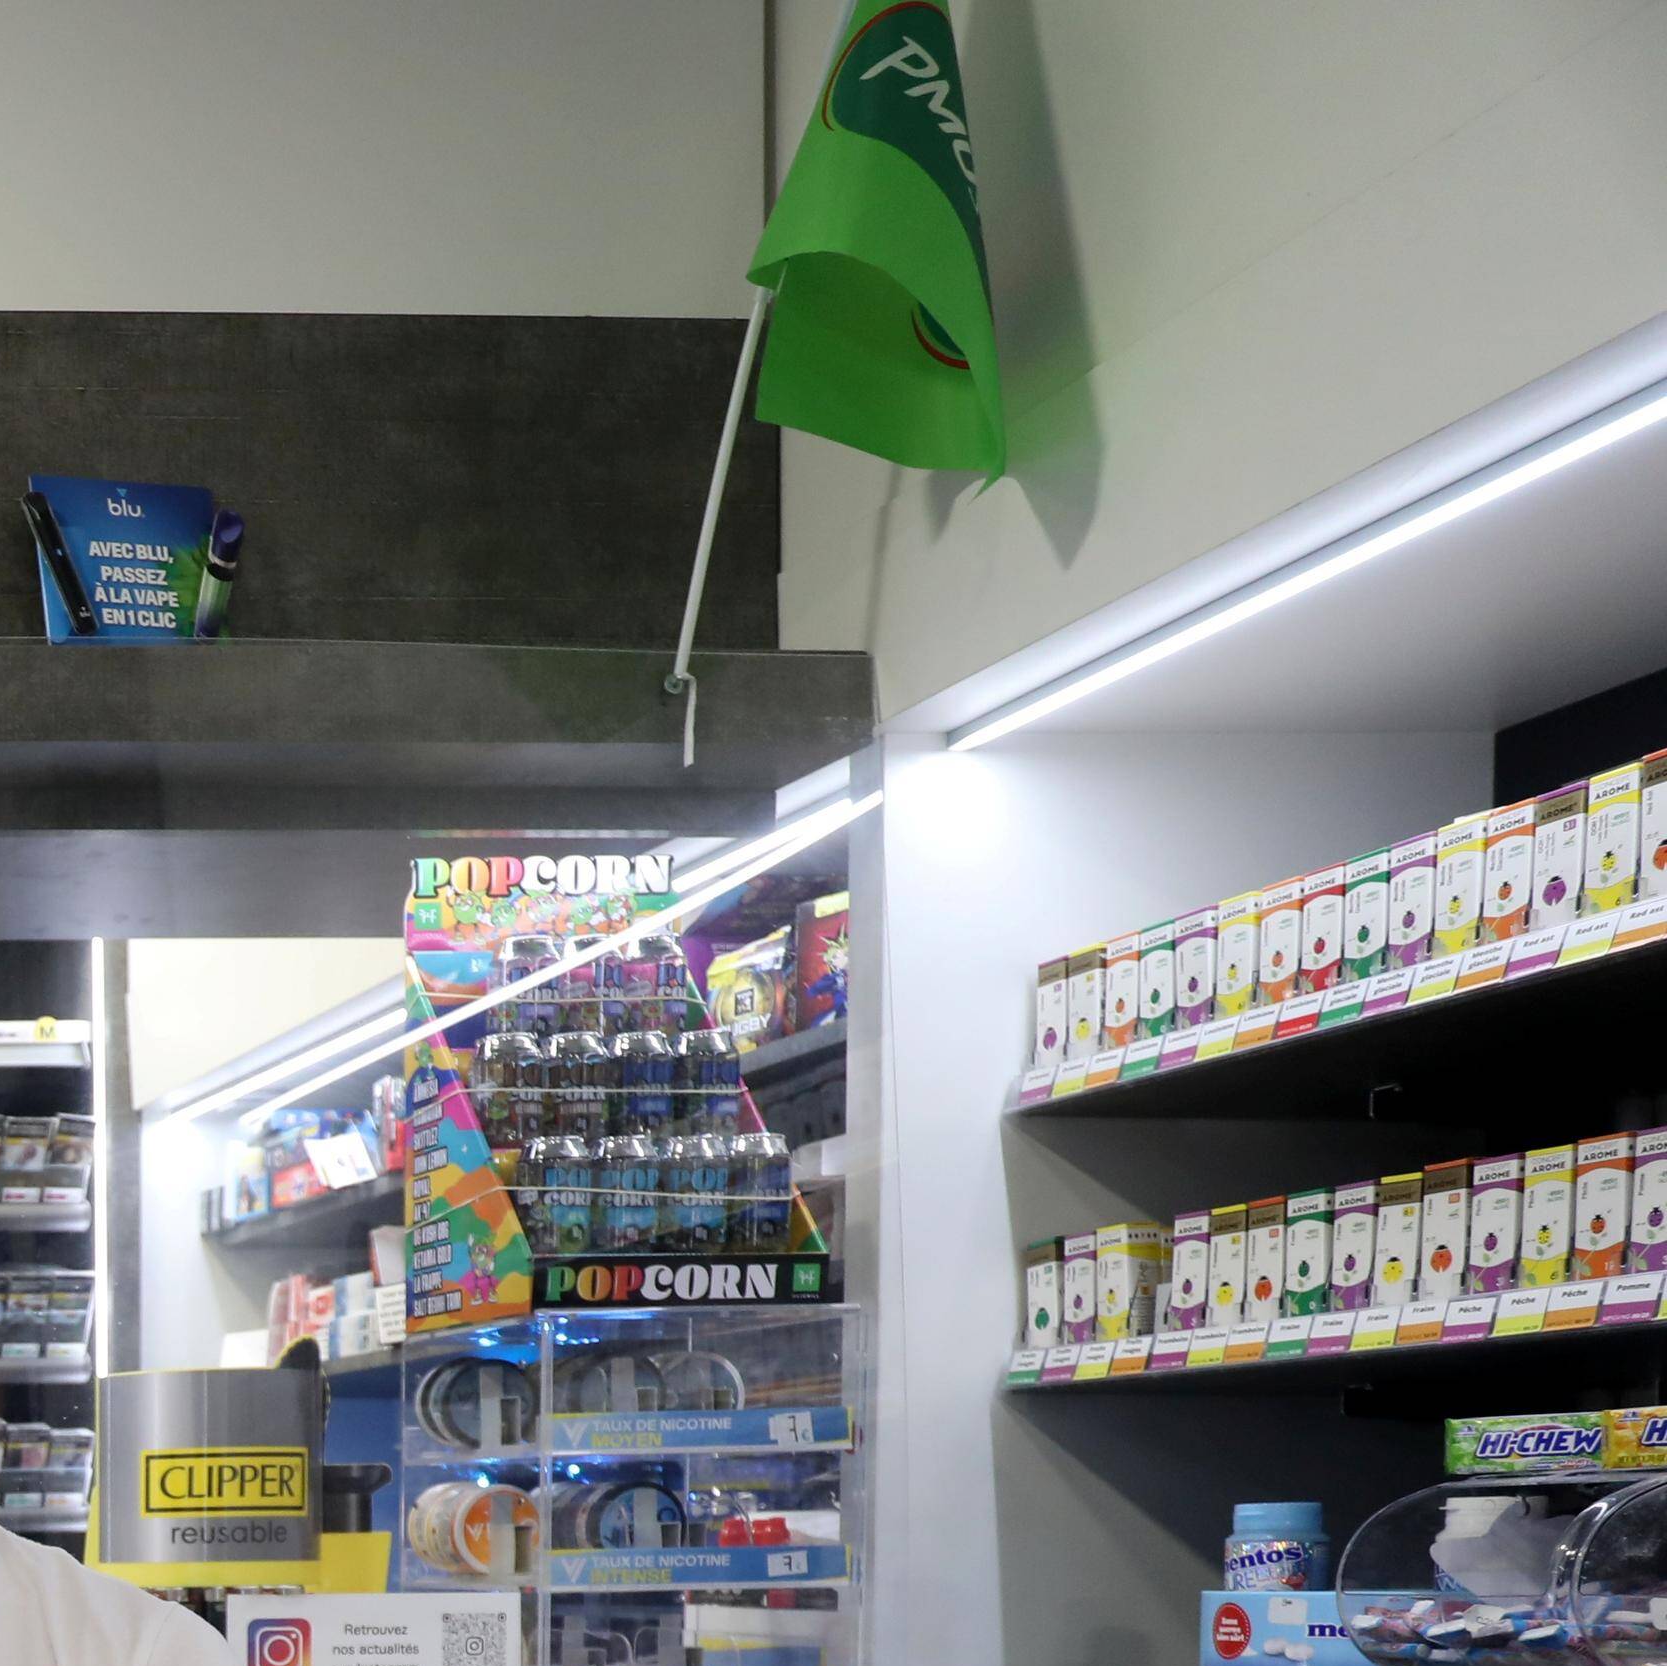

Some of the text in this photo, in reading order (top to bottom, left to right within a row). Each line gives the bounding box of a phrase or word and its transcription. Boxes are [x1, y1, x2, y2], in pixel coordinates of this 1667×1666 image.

[107, 498, 146, 518] blu
[89, 541, 174, 564] AVEC BLU,
[100, 565, 168, 585] PASSEZ
[95, 582, 179, 608] À LA VAPE
[102, 608, 177, 629] EN 1 CLIC
[413, 854, 674, 899] POPCORN
[1583, 1148, 1618, 1162] AROME
[1531, 1160, 1566, 1174] AROME
[546, 1263, 778, 1302] POPCORN
[1616, 1279, 1652, 1292] Pomme
[592, 1416, 732, 1433] TAUX DE NICOTINE
[591, 1432, 663, 1448] MOYEN
[1475, 1426, 1602, 1459] HI-CHEW
[159, 1463, 296, 1500] CLIPPER
[171, 1519, 288, 1545] reusable
[592, 1554, 731, 1569] TAUX DE NICOTINE
[591, 1568, 672, 1583] INTENSE
[344, 1623, 408, 1637] Retrouvez
[332, 1641, 419, 1655] nos actualités
